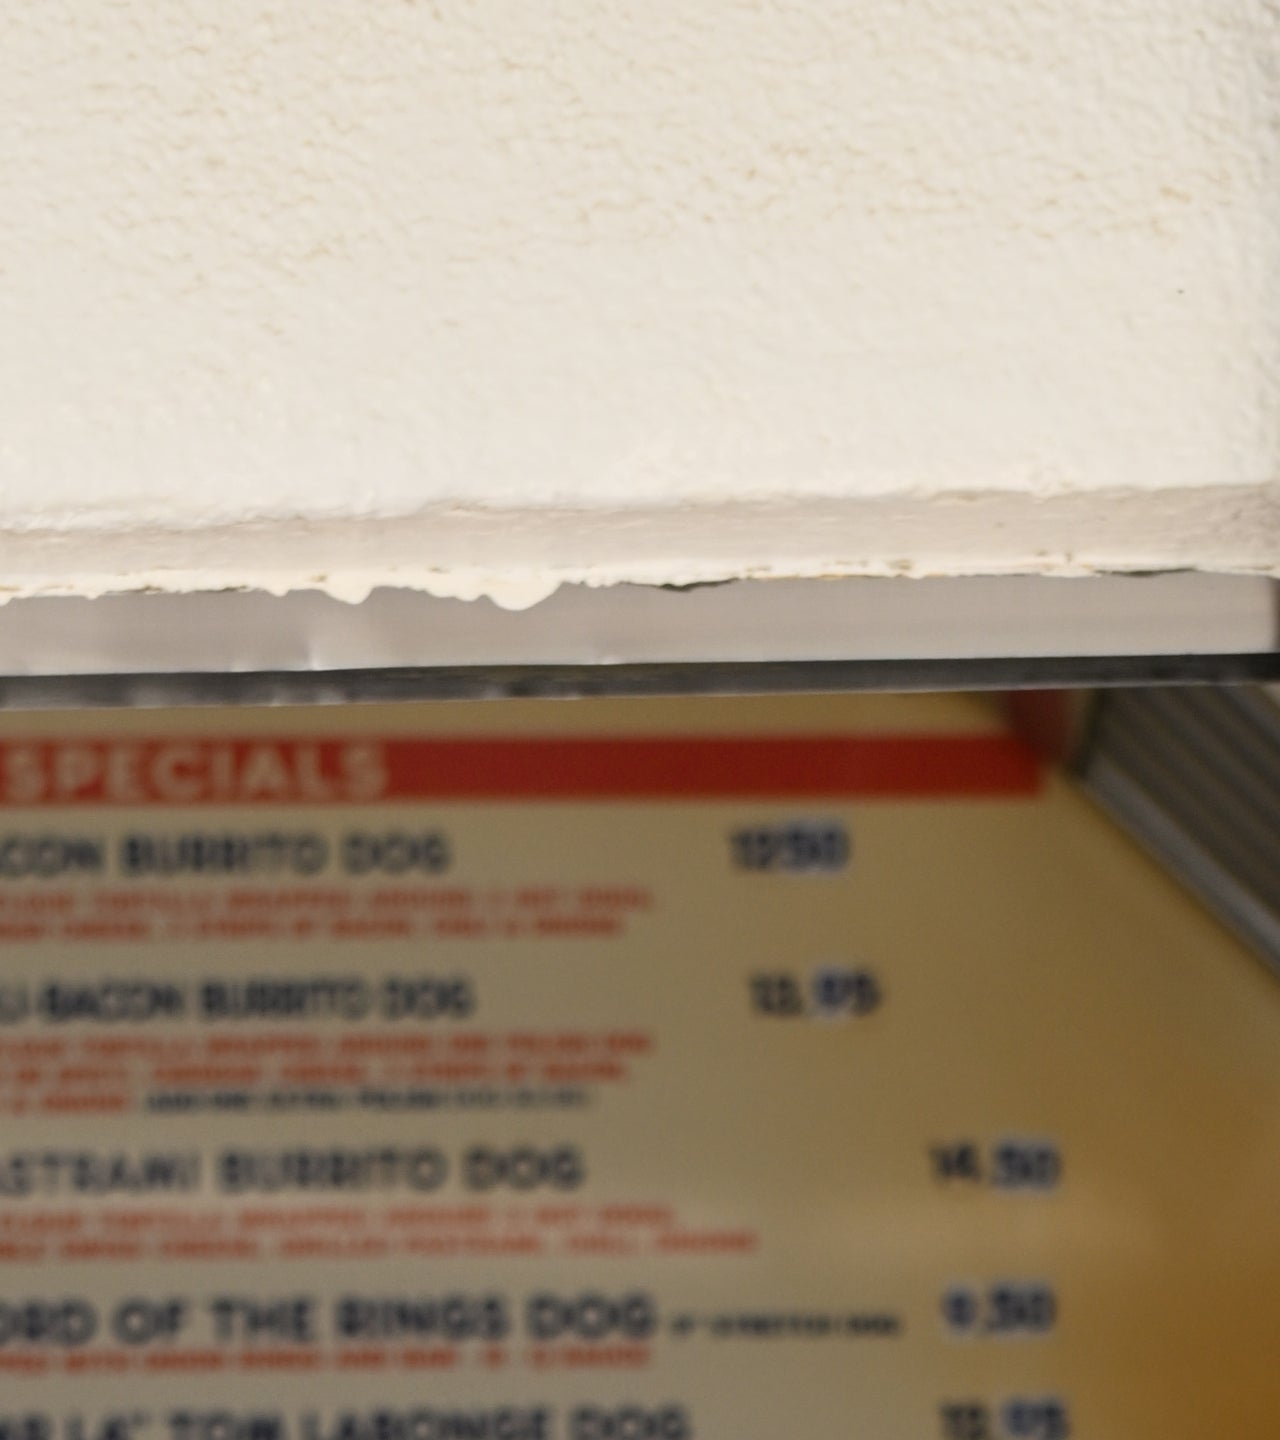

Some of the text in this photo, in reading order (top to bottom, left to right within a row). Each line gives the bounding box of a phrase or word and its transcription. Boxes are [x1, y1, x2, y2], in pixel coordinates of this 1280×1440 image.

[3, 742, 387, 801] SPECIALS
[118, 832, 328, 877] BURRITO
[339, 831, 451, 875] DOG
[197, 978, 368, 1019] BURRITO
[380, 977, 474, 1019] DOG
[216, 1144, 449, 1193] BURRITO
[462, 1144, 586, 1191] DOG
[109, 1297, 188, 1347] OF
[209, 1296, 314, 1345] THE
[335, 1295, 510, 1341] RINGS
[525, 1292, 659, 1342] DOG
